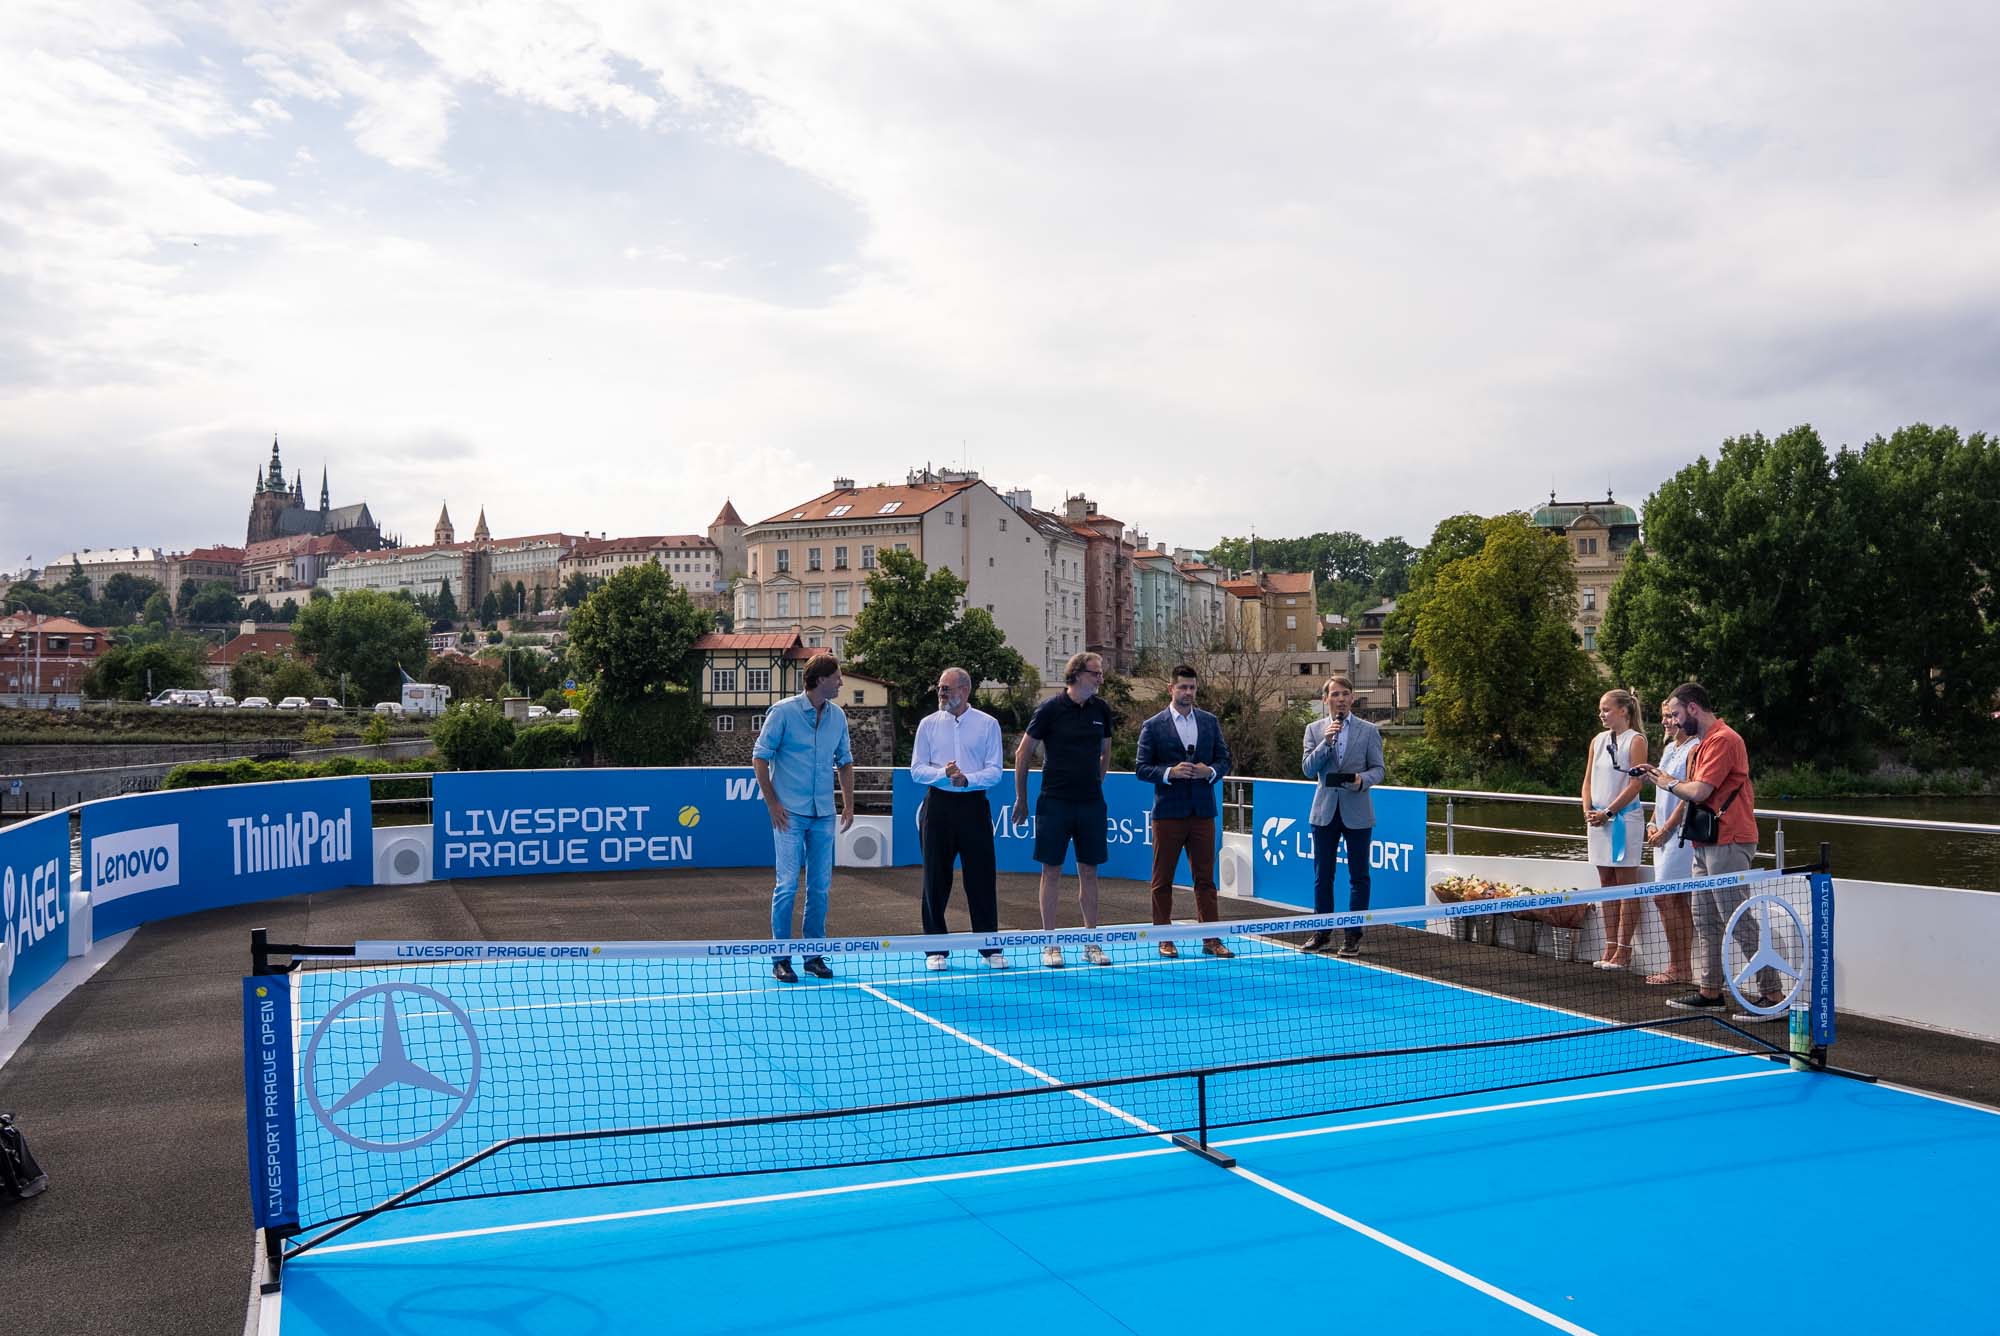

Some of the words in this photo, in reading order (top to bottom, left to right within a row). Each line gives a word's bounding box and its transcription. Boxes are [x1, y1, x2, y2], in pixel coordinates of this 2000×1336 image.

[444, 806, 650, 836] LIVESPORT
[227, 808, 352, 875] ThinkPad
[444, 838, 589, 868] PRAGUE
[600, 836, 693, 863] OPEN
[1296, 831, 1414, 872] LIORT
[96, 846, 169, 887] Lenovo
[1634, 882, 1681, 895] LIVESPORT
[1682, 879, 1715, 891] PRAGUE
[1716, 875, 1738, 886] OPEN
[16, 856, 65, 956] AGEL
[1445, 902, 1498, 916] LIVESPORT
[1500, 898, 1537, 910] PRAGUE
[1538, 895, 1563, 906] OPEN
[1820, 880, 1829, 944] LIVESPORT
[985, 935, 1054, 947] LIVESPORT
[1056, 933, 1103, 944] PRAGUE
[1106, 931, 1137, 942] OPEN
[1230, 921, 1290, 935] LIVESPORT
[1293, 917, 1334, 930] PRAGUE
[1336, 915, 1364, 926] OPEN
[397, 946, 483, 957] LIVESPORT
[487, 946, 546, 957] PRAGUE
[550, 946, 589, 957] OPEN
[707, 943, 785, 956] LIVESPORT
[789, 942, 841, 953] PRAGUE
[845, 941, 879, 951] OPEN
[1820, 946, 1829, 995] PRAGUE
[260, 1000, 276, 1045] OPEN
[1820, 997, 1829, 1028] OPEN
[262, 1049, 278, 1117] PRAGUE
[265, 1122, 282, 1217] LIVESPORT
